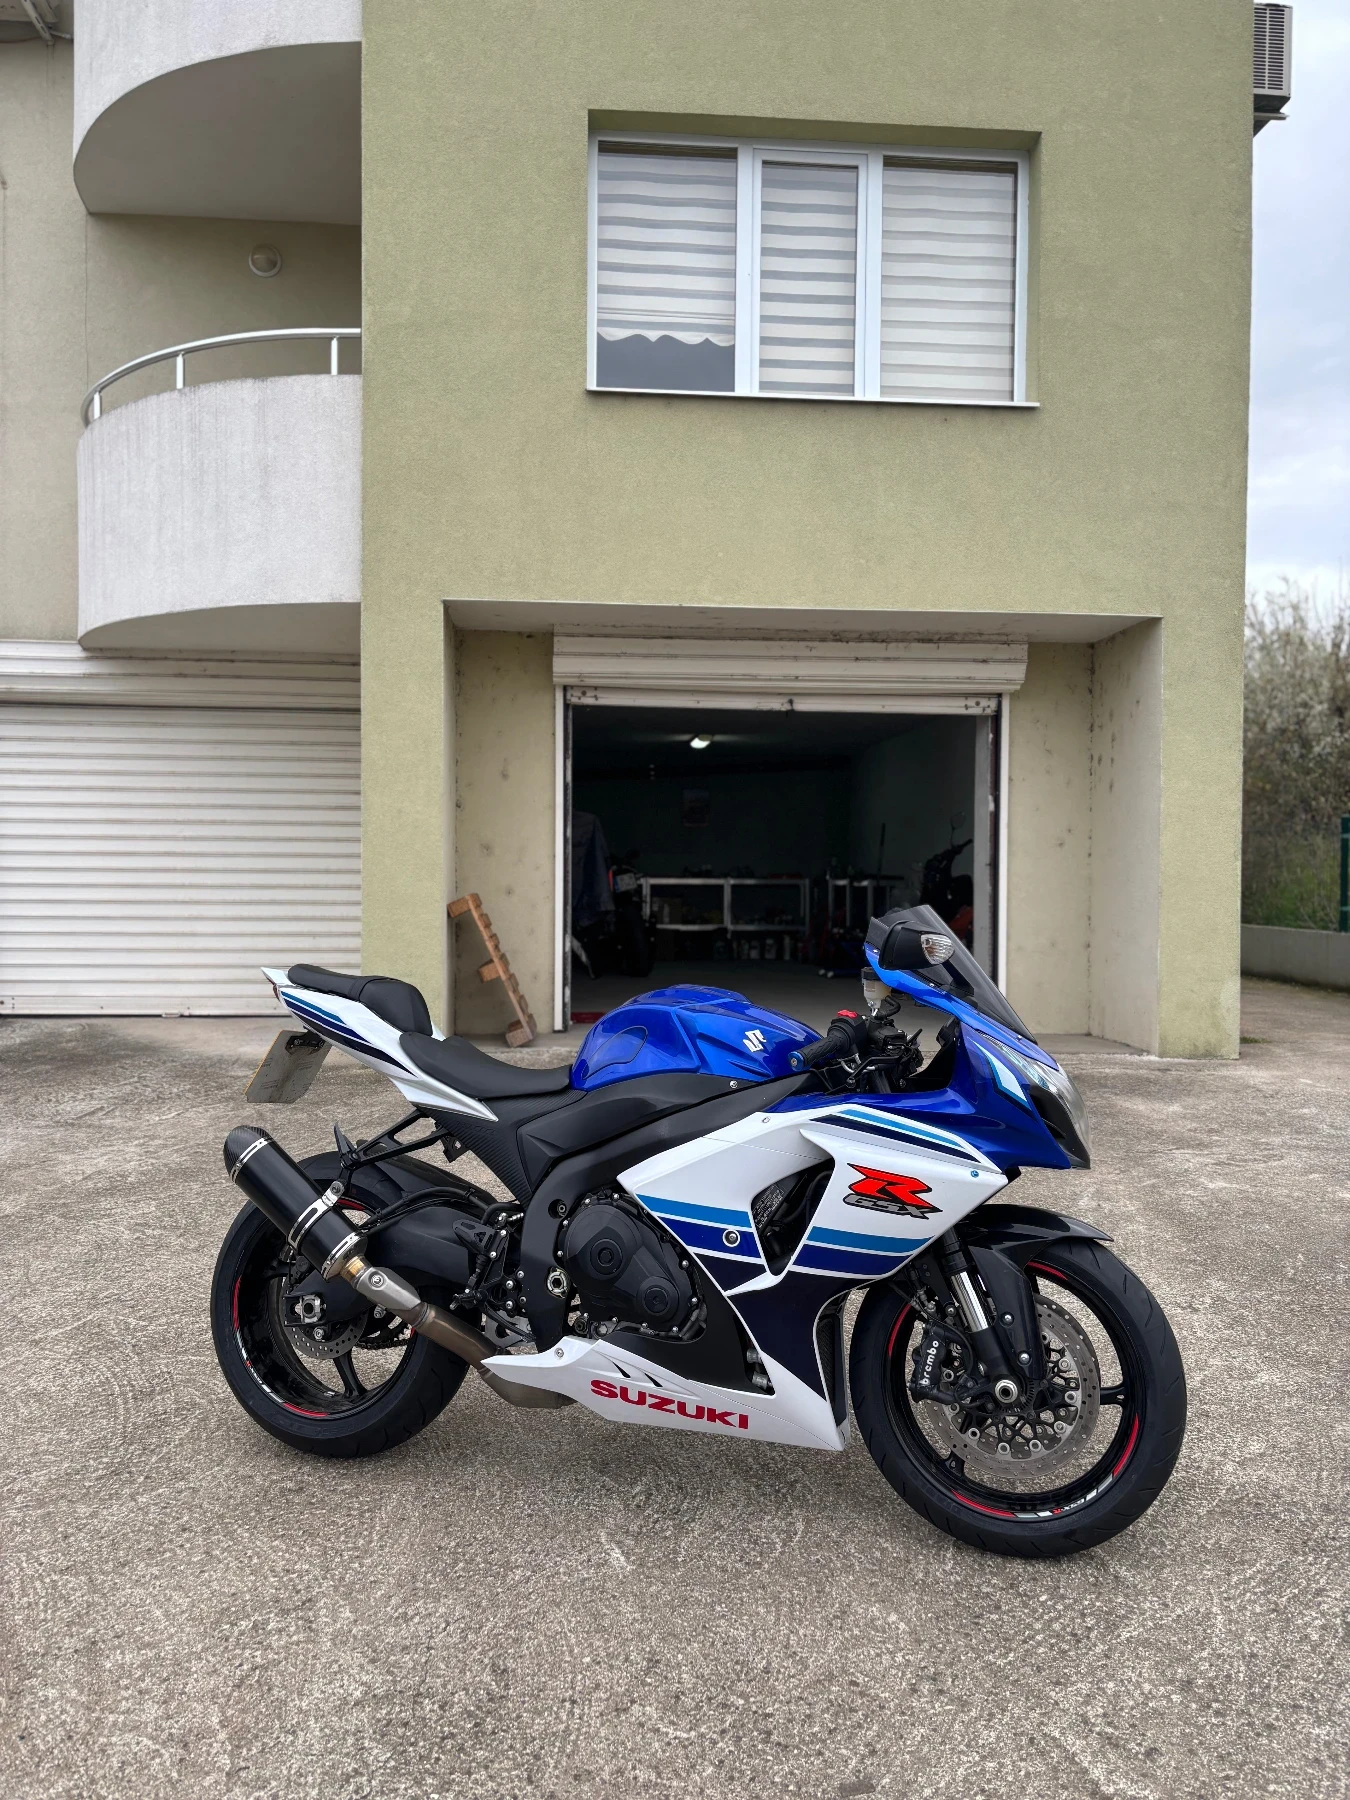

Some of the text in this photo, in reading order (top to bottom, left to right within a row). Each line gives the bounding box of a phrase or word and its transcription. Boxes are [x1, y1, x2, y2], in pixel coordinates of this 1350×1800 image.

[843, 1193, 931, 1220] GSX
[847, 1162, 943, 1213] R
[919, 1340, 939, 1385] brembo
[590, 1379, 749, 1430] SUZUKI
